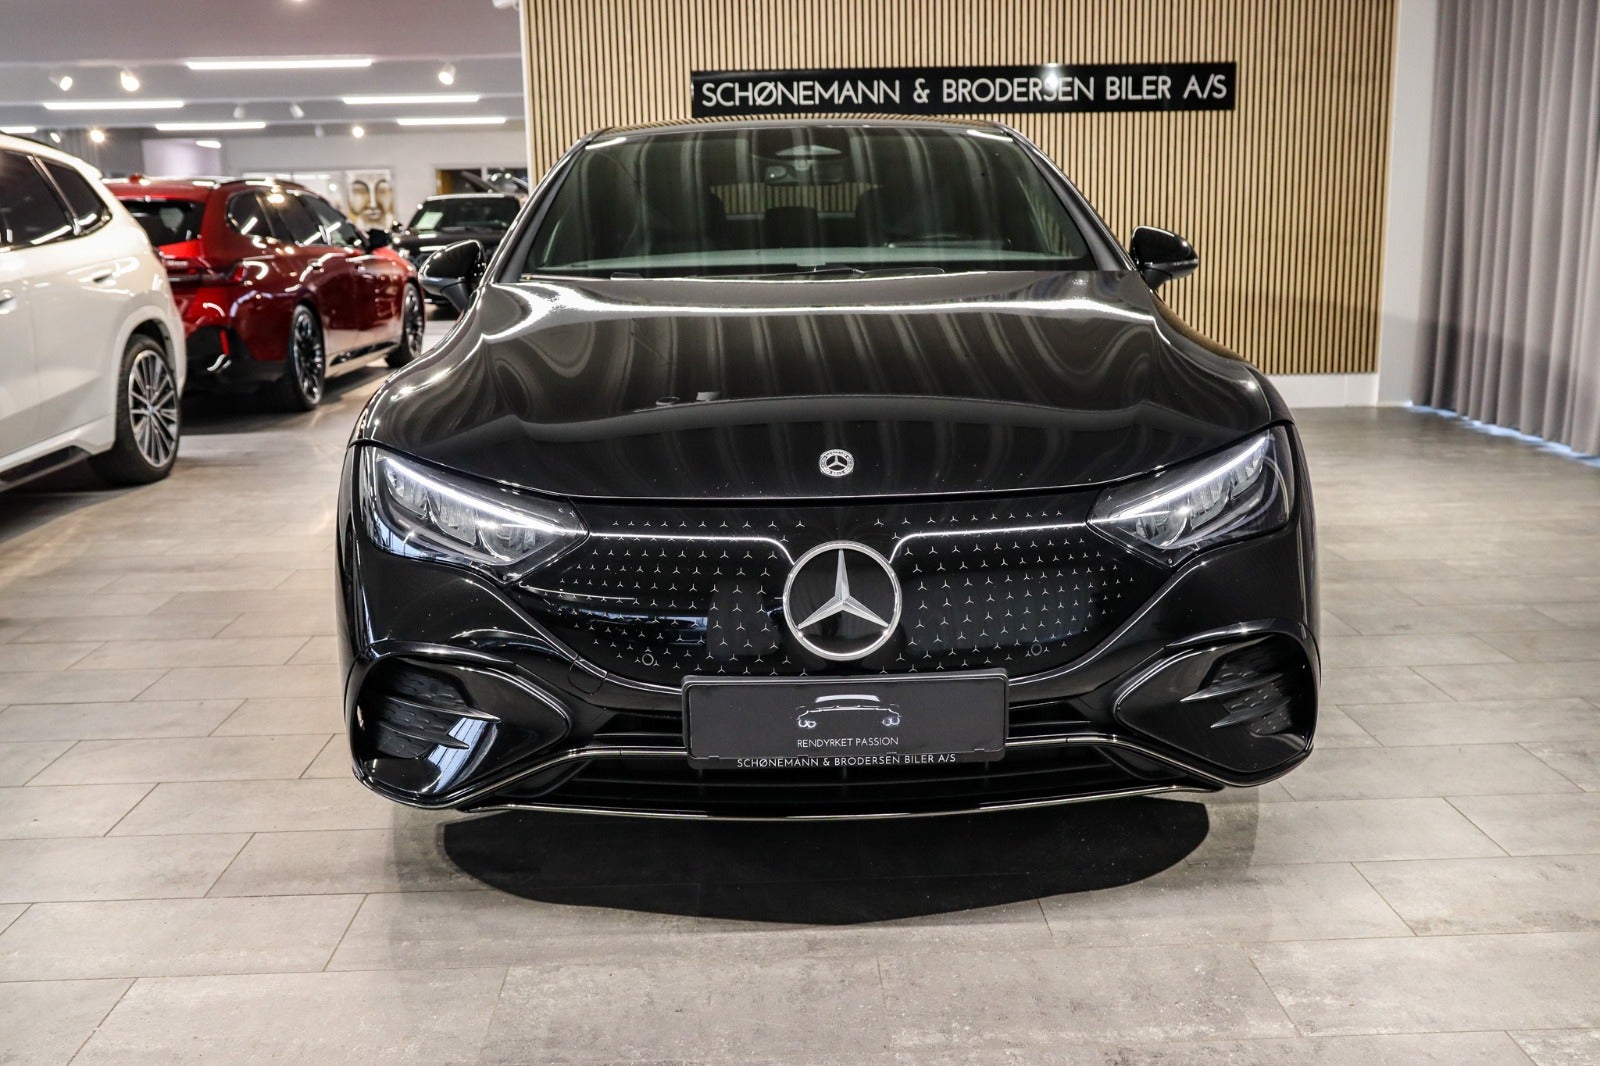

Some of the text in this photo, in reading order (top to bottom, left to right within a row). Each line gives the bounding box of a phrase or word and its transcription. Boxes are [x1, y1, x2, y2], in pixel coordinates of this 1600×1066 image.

[702, 74, 1227, 106] SCHØNEMANN & BRODERSEN BILER A/S
[797, 736, 899, 748] RENDYRKET PASSION
[737, 752, 957, 768] SCHØNEMANN & BRODERSEN BILER A/S
